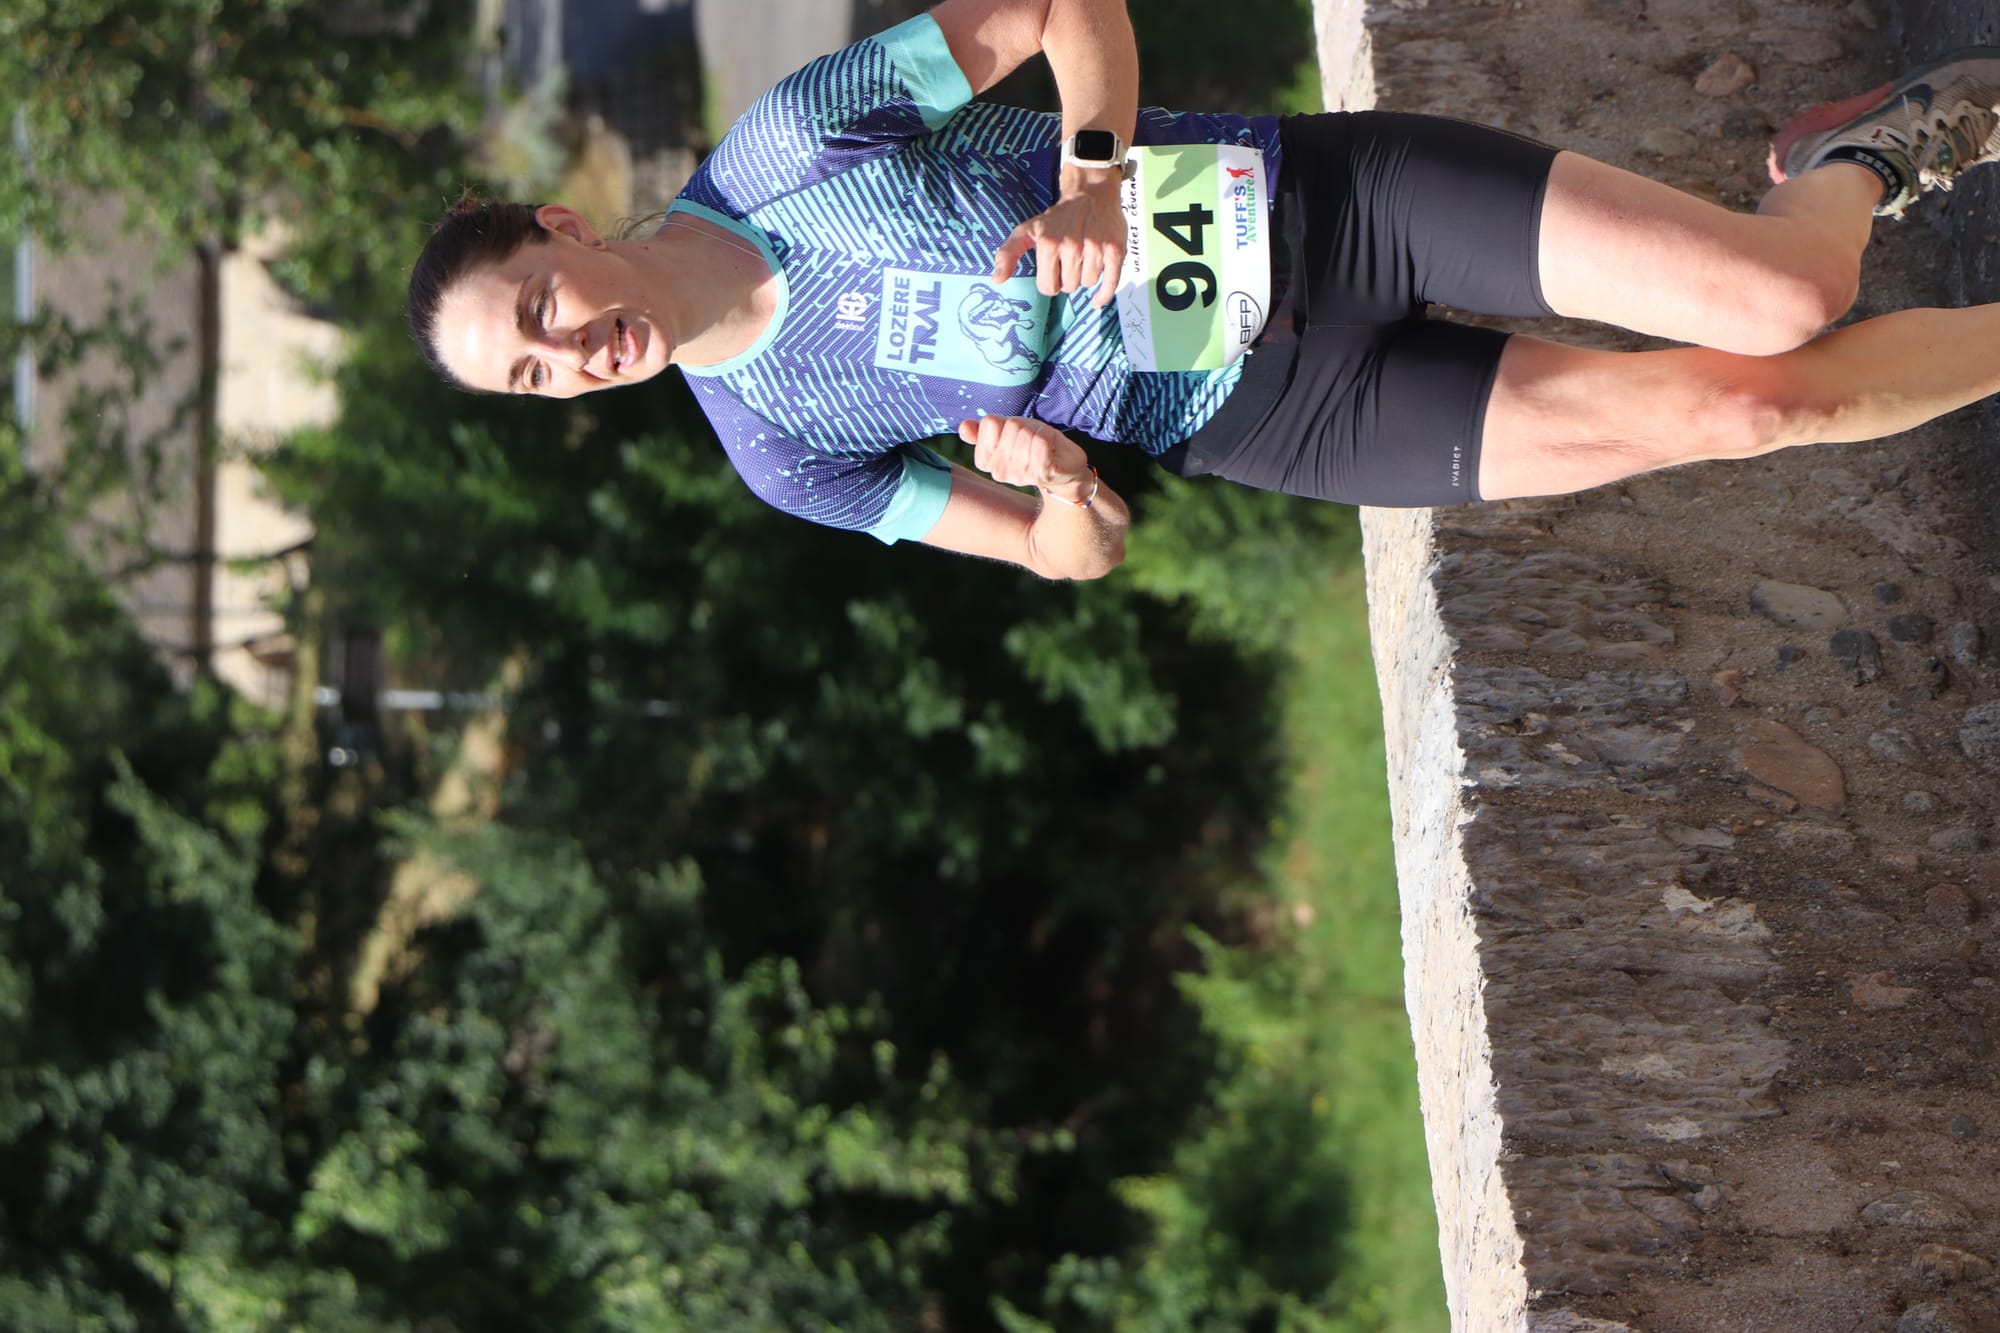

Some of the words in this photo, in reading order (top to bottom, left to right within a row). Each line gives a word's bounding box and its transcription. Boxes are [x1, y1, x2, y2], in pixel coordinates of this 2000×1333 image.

[1234, 184, 1248, 250] TUFF'S
[1246, 178, 1257, 243] Aventure
[1152, 203, 1217, 311] 94
[887, 276, 910, 361] LOZÈRE
[909, 281, 942, 364] TRAIL
[1240, 299, 1252, 344] BFP
